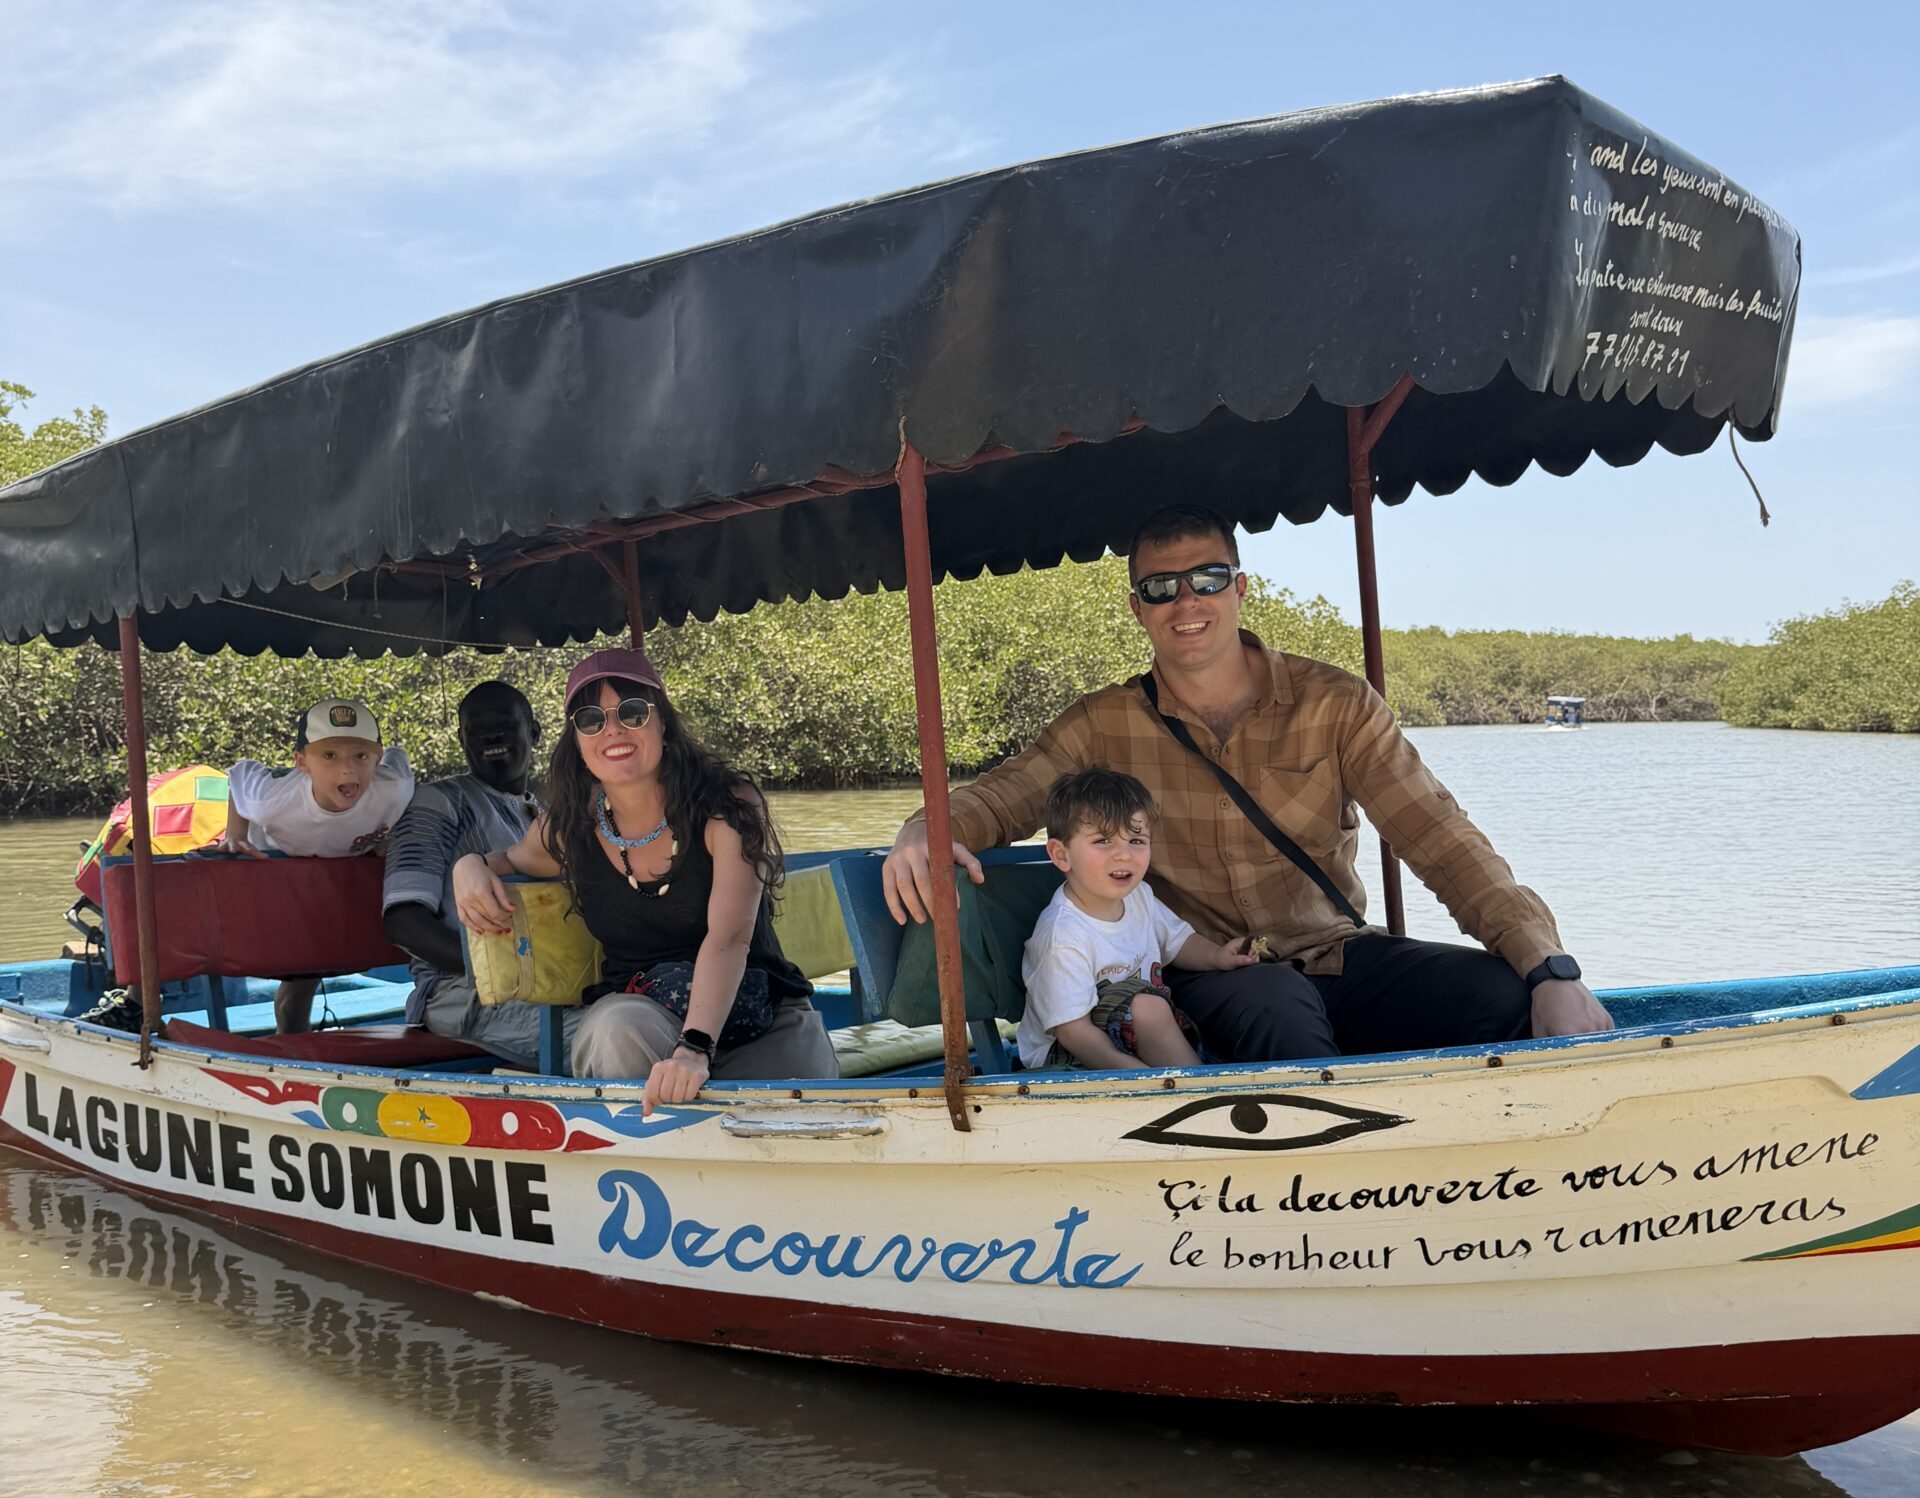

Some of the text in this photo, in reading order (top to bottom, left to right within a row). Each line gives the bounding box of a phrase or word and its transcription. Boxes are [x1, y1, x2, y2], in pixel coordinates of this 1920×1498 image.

[1724, 189, 1739, 209] en
[1651, 310, 1683, 337] doux
[1743, 289, 1783, 323] fruits
[25, 1071, 555, 1246] LAGUNE SOMONE
[1218, 1175, 1264, 1213] la
[1279, 1166, 1543, 1213] decouverte
[1562, 1159, 1678, 1193] vous
[1693, 1132, 1880, 1181] amene
[597, 1168, 1145, 1289] Decouverte
[1169, 1230, 1208, 1268] le
[1224, 1233, 1400, 1271] bonheur
[1544, 1196, 1847, 1253] rameneras
